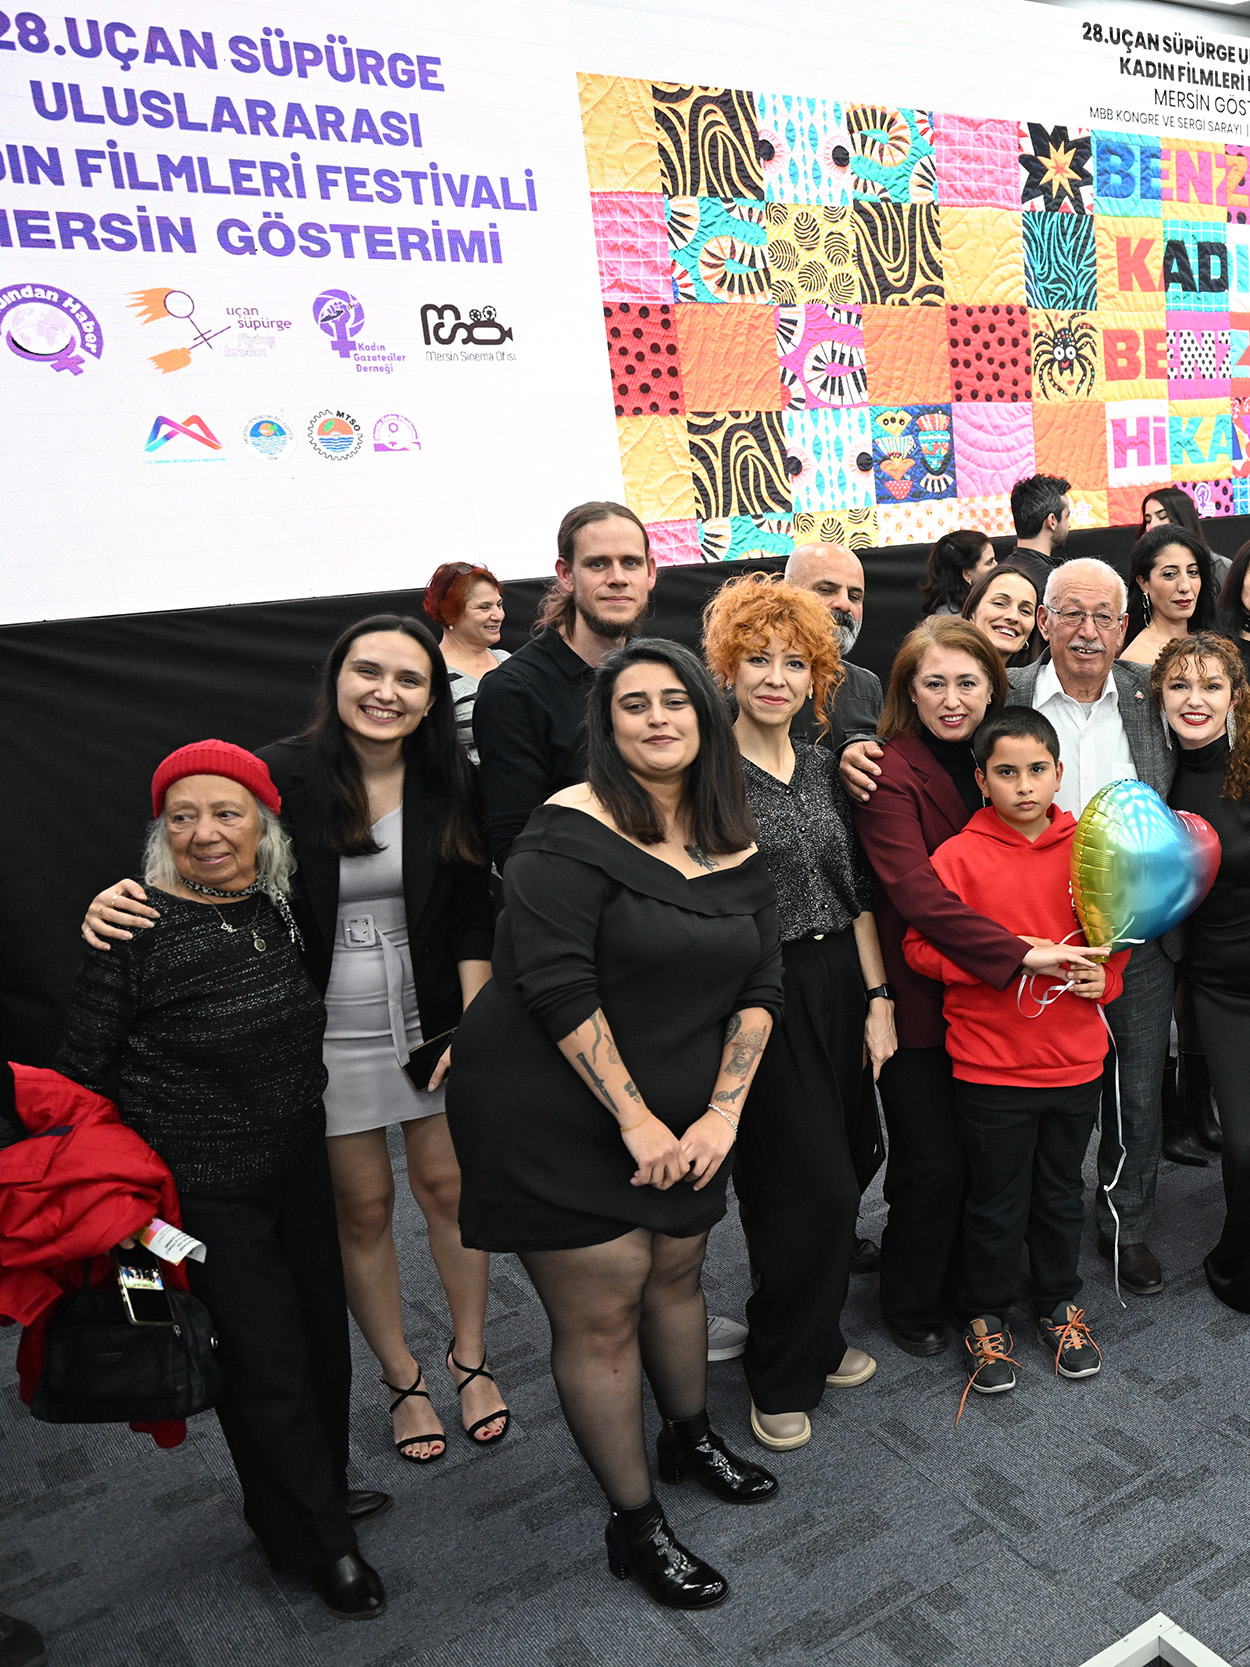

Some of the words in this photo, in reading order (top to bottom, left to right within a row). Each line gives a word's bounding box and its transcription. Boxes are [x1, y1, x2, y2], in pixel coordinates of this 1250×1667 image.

[1082, 22, 1160, 53] 28.UÇAN
[1162, 32, 1236, 63] SÜPÜRGE
[228, 27, 445, 91] SÜPÜRGE
[1119, 57, 1175, 82] KADIN
[1178, 62, 1245, 91] FİLMLERİ
[29, 80, 423, 148] ULUSLARARASI
[1154, 89, 1211, 112] MERSİN
[1089, 107, 1114, 120] MBB
[1116, 109, 1160, 126] KONGRE
[1162, 114, 1175, 128] VE
[1177, 117, 1206, 131] SERGİ
[1208, 121, 1242, 135] SARAYI
[75, 139, 307, 199] FİLMLERİ
[316, 161, 537, 211] FESTİVALİ
[0, 205, 197, 253] ERSİN
[216, 211, 503, 263] GÖSTERİMİ
[62, 296, 98, 354] Haber
[226, 307, 259, 319] uçan
[237, 317, 292, 331] süpürge
[357, 342, 386, 351] Kadın
[425, 351, 459, 361] Mersin
[335, 409, 361, 432] MTSO
